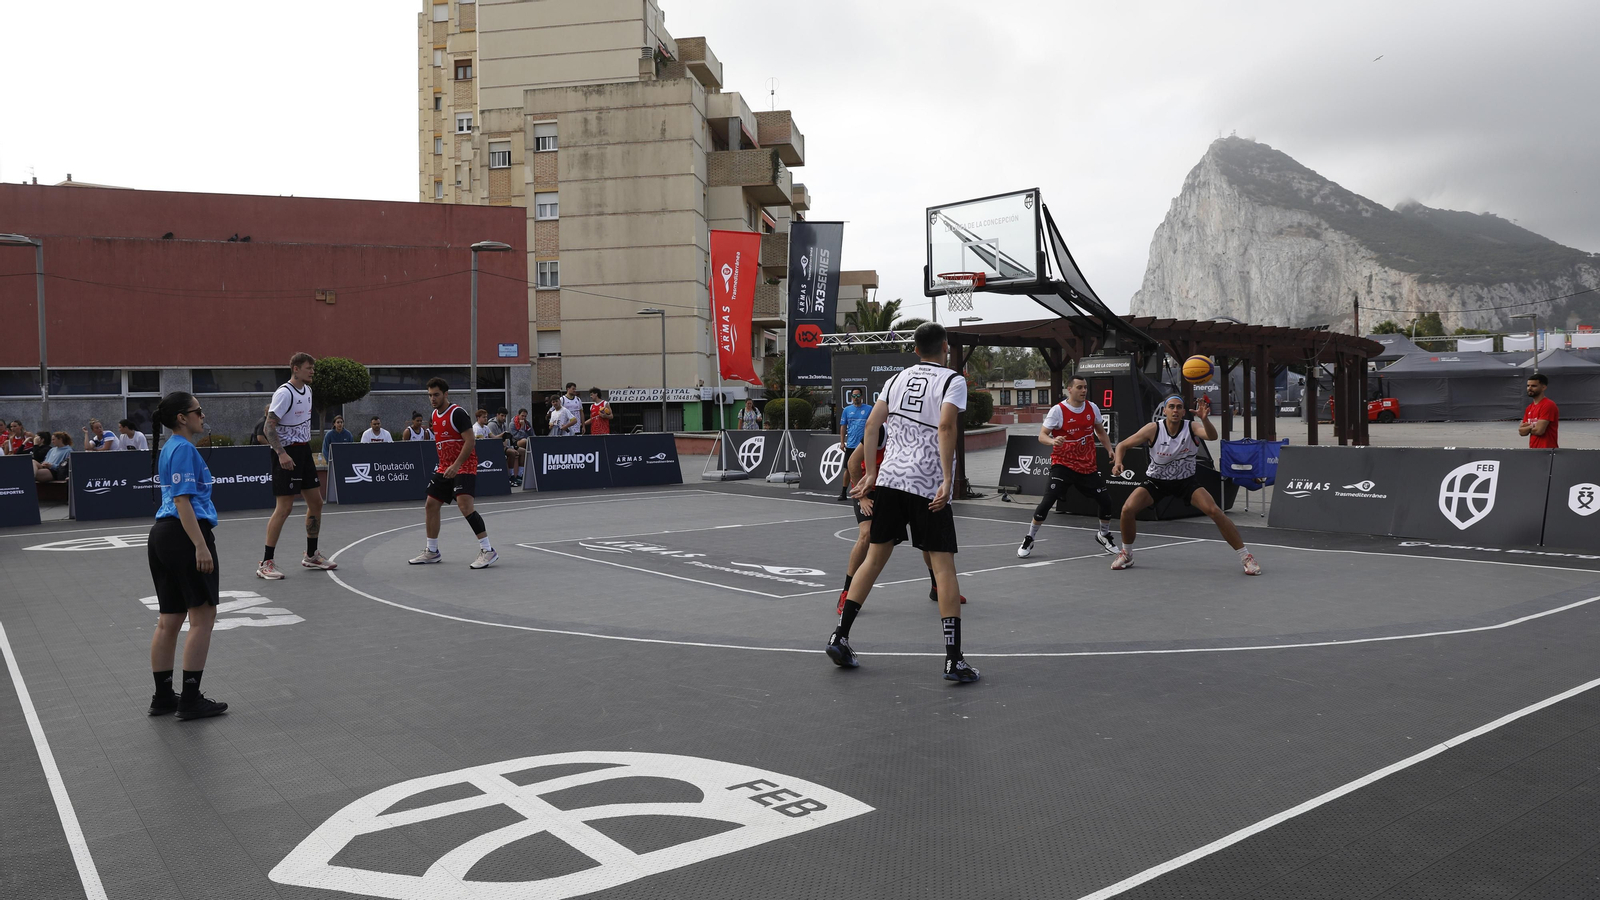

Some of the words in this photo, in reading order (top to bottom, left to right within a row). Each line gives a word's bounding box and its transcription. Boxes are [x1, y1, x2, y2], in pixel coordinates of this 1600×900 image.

[983, 214, 1019, 227] CONCEPCIÓN
[815, 248, 830, 314] 3X3SERIES
[722, 305, 730, 352] ARMAS
[1193, 383, 1219, 392] Energía
[900, 376, 928, 413] 2
[1103, 389, 1113, 407] 8
[438, 442, 442, 450] 3
[1081, 437, 1086, 445] 2
[548, 452, 595, 464] MUNDO
[1035, 456, 1051, 466] Diput
[373, 461, 414, 472] Diputación
[1033, 467, 1041, 475] de
[236, 472, 272, 484] Energía
[388, 473, 409, 481] Cádiz
[86, 479, 127, 488] ARMAS
[1287, 481, 1331, 491] ARMAS
[943, 618, 955, 646] ELITE
[725, 778, 827, 818] FEB
